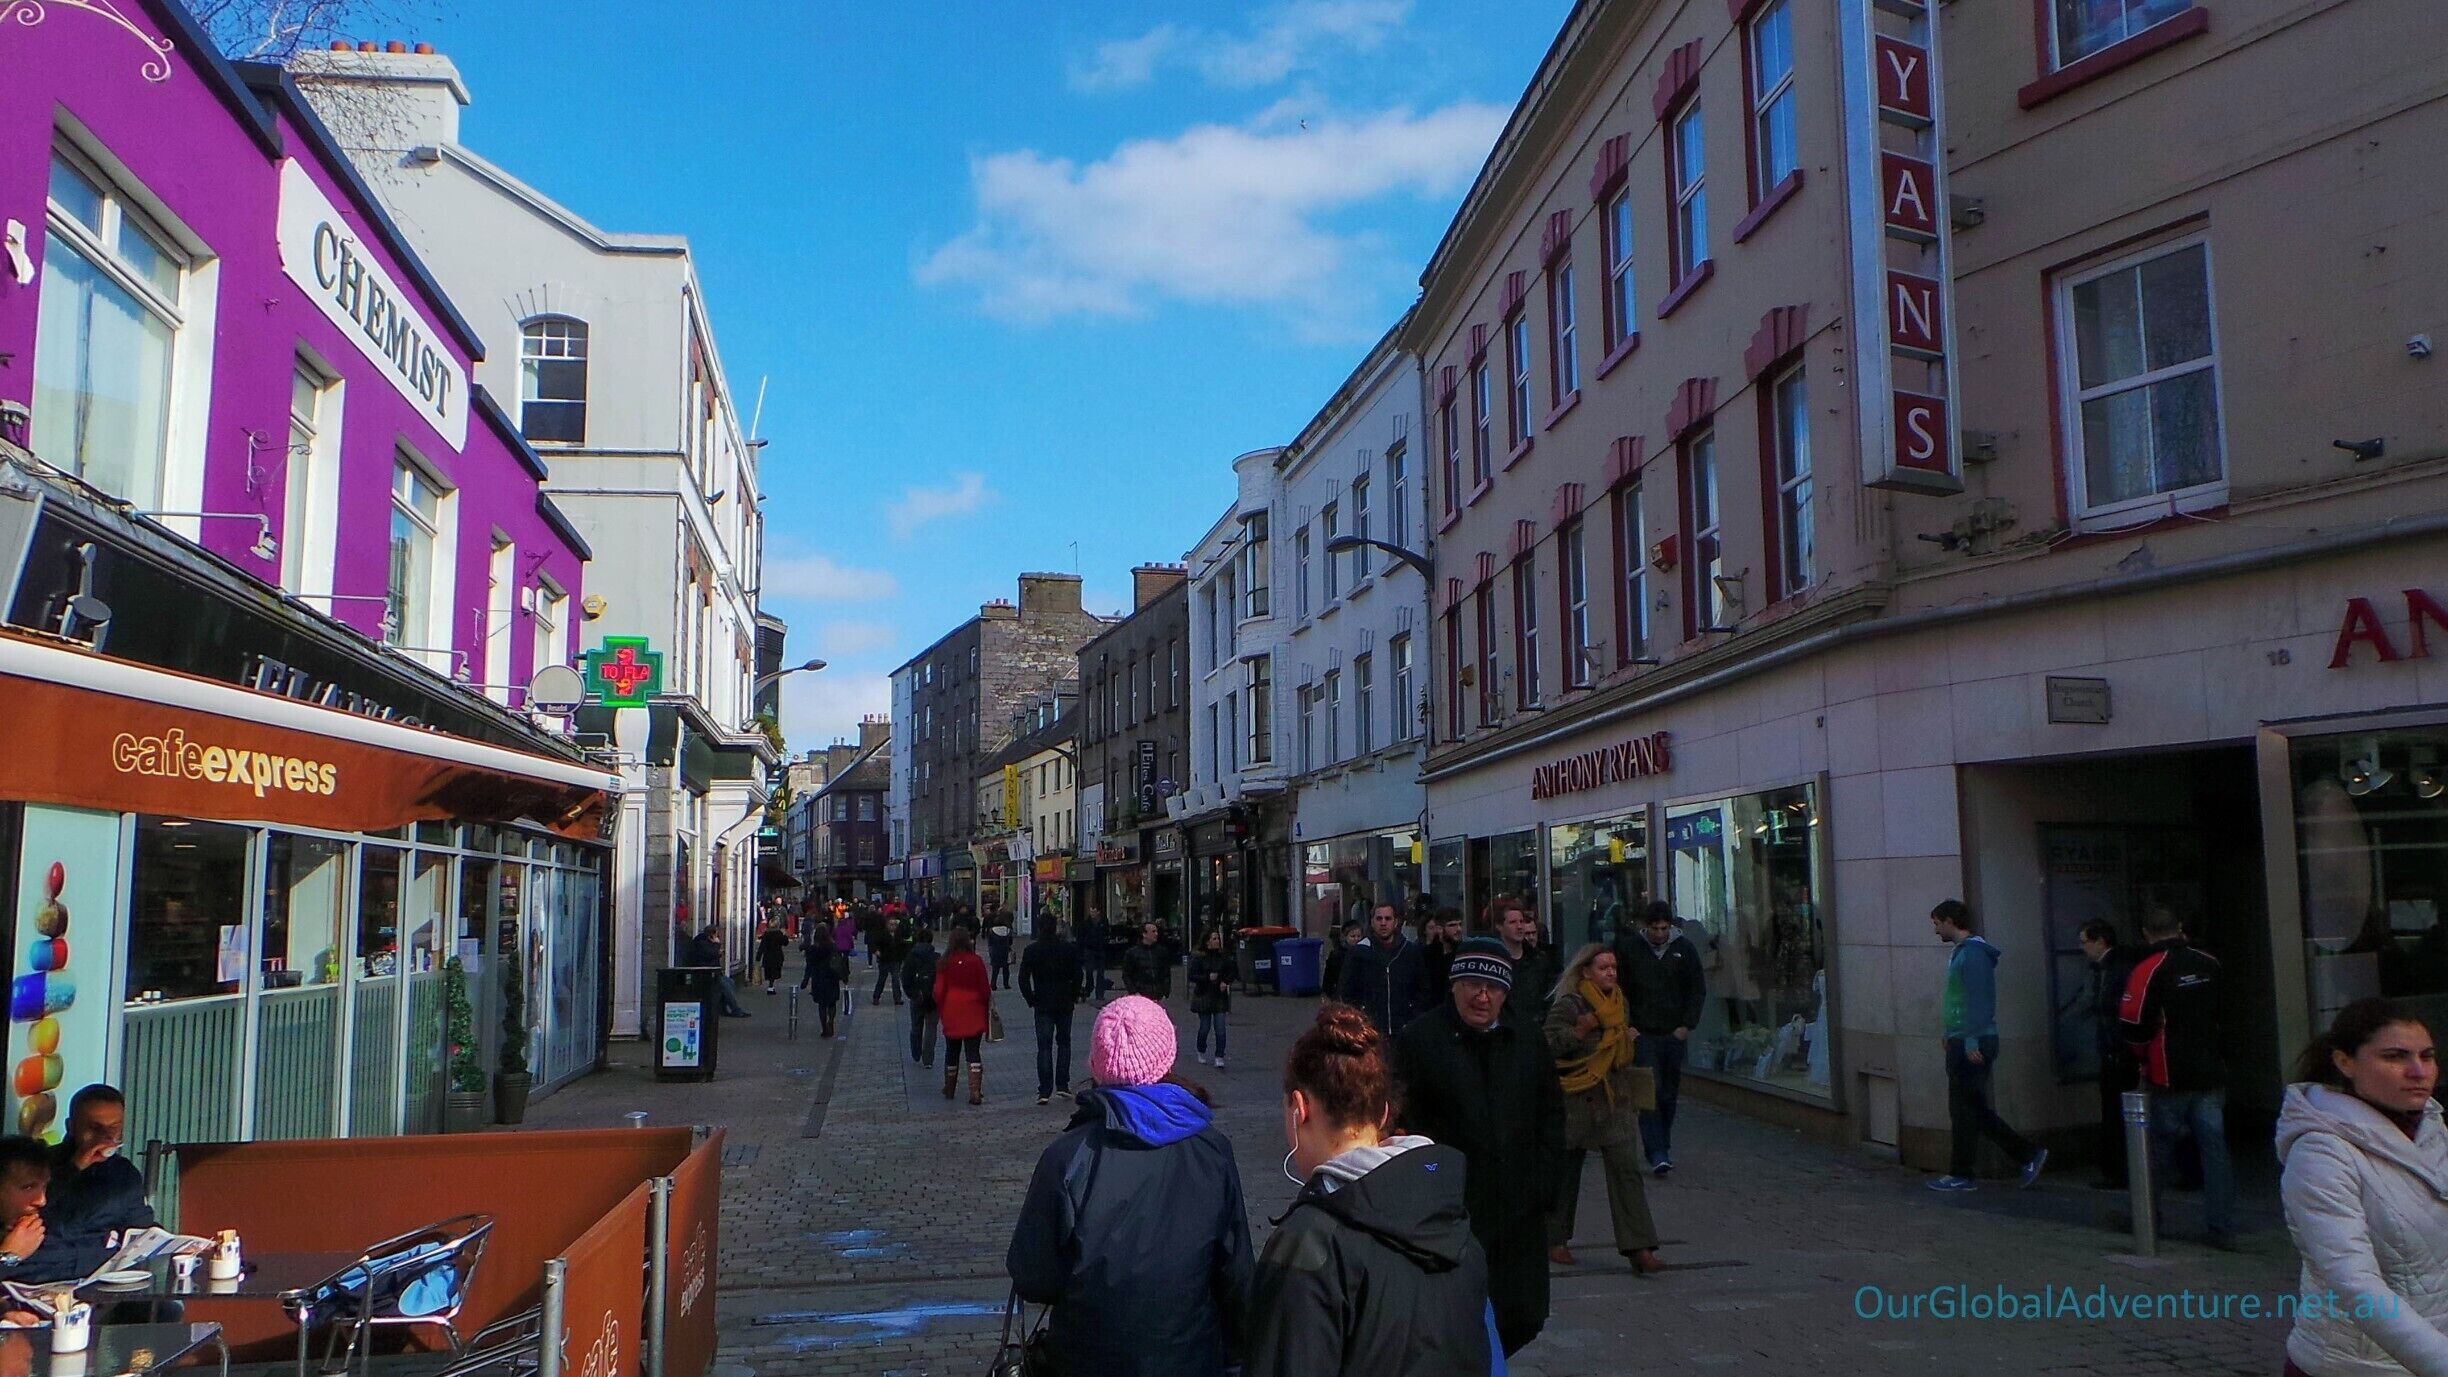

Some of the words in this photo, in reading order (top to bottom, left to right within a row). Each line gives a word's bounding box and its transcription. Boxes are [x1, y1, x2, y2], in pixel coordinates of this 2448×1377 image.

[313, 220, 451, 418] CHEMIST
[1530, 748, 1607, 800] ANTHONY
[1609, 731, 1671, 782] RYANS
